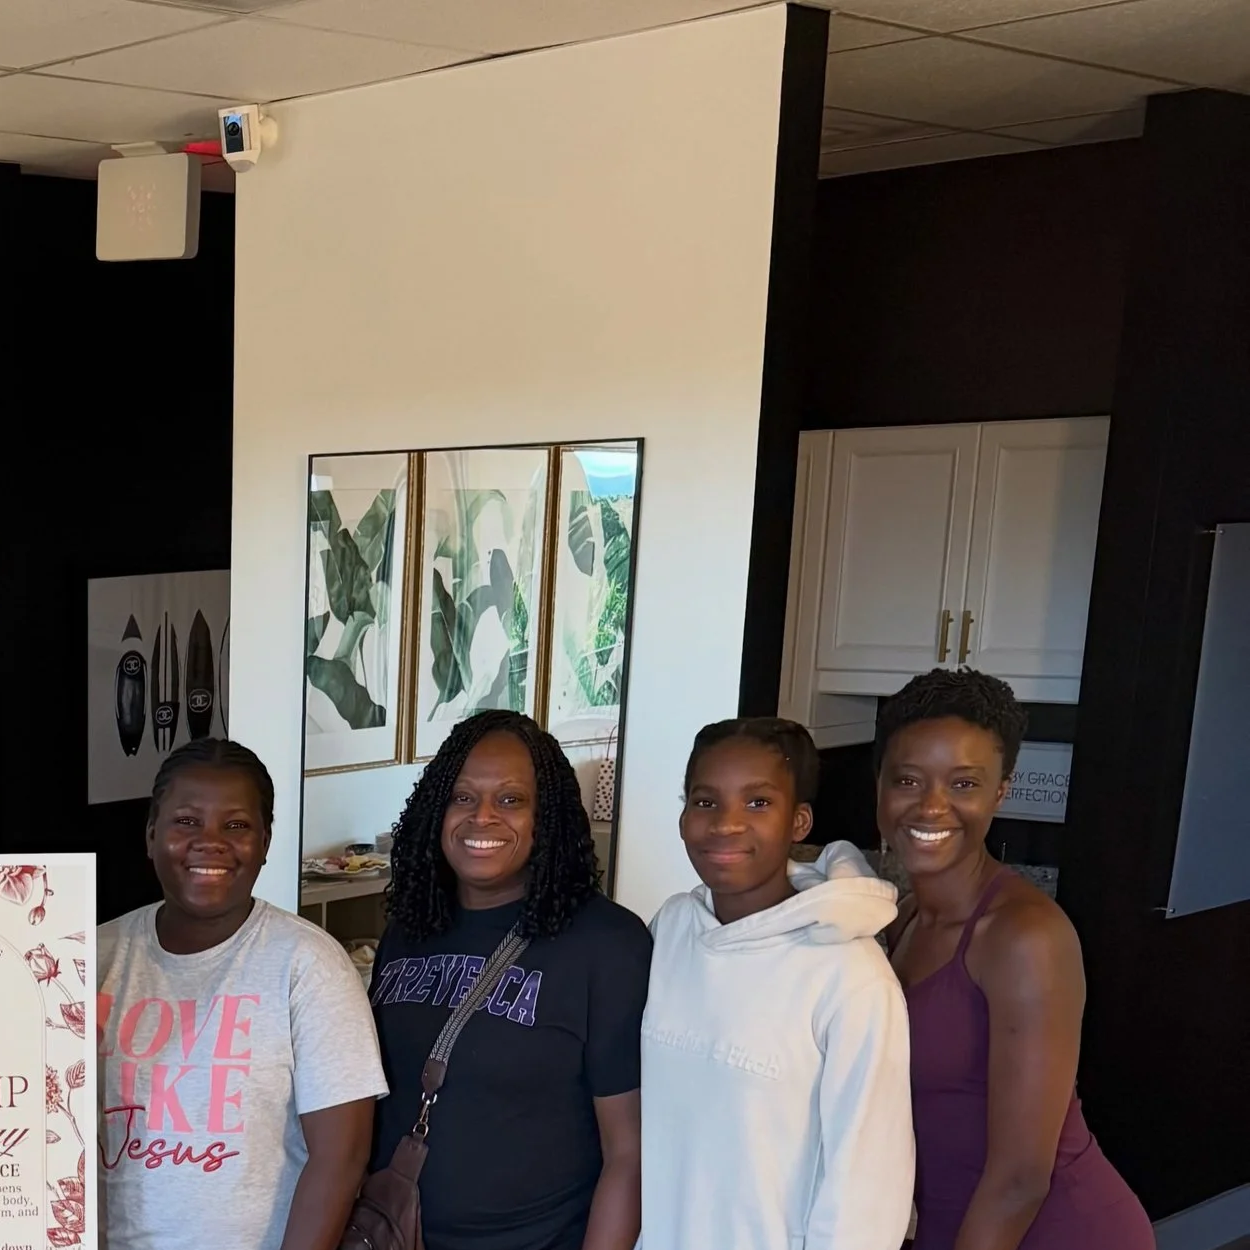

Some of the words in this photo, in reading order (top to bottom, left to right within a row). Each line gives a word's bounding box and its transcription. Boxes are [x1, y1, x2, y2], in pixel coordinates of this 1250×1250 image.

[1004, 787, 1068, 804] ERFECTION
[372, 954, 542, 1026] TREVECA
[105, 1062, 251, 1134] IKE
[97, 1105, 240, 1172] Jesus
[17, 1206, 39, 1217] and
